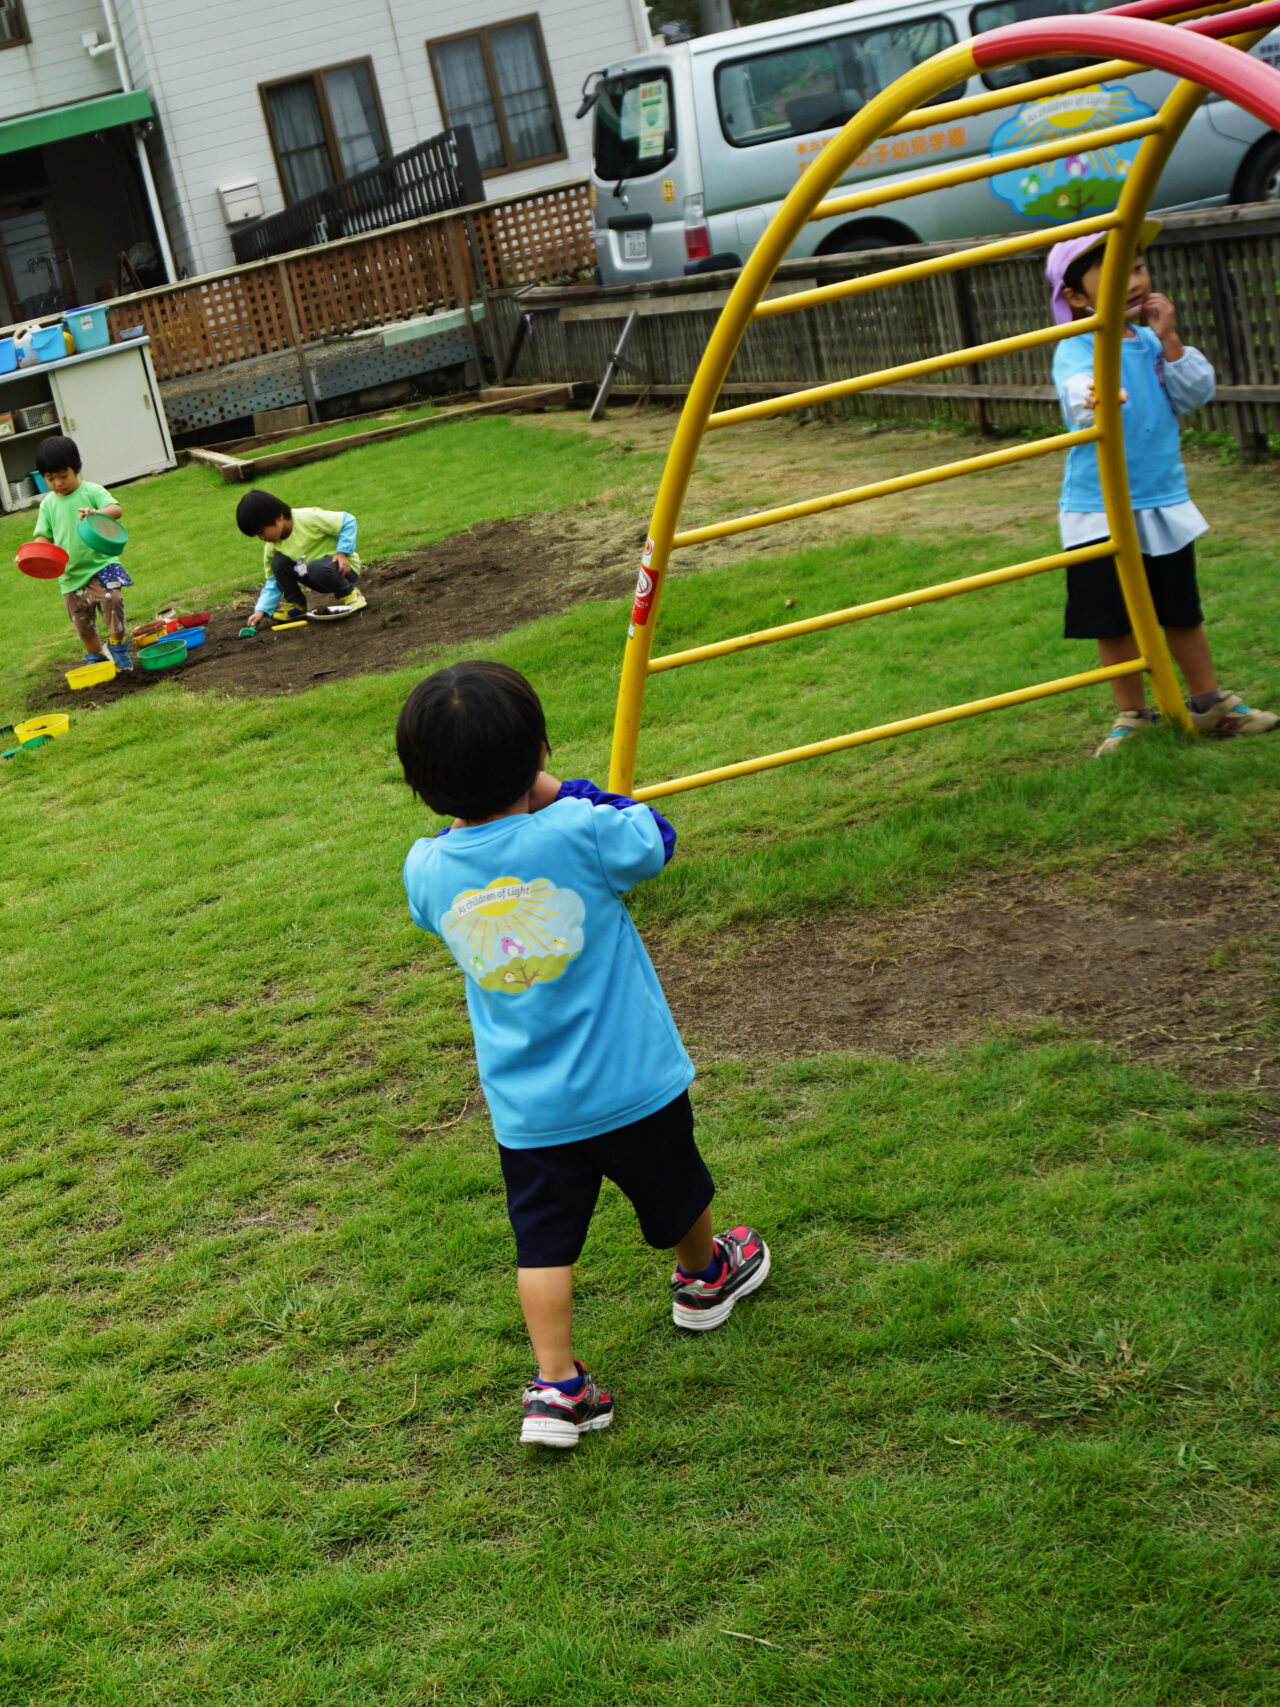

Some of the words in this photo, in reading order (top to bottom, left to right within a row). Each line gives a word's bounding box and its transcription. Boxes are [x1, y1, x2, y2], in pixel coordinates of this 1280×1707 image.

[466, 893, 496, 910] children
[497, 888, 506, 900] of
[507, 885, 530, 898] Light
